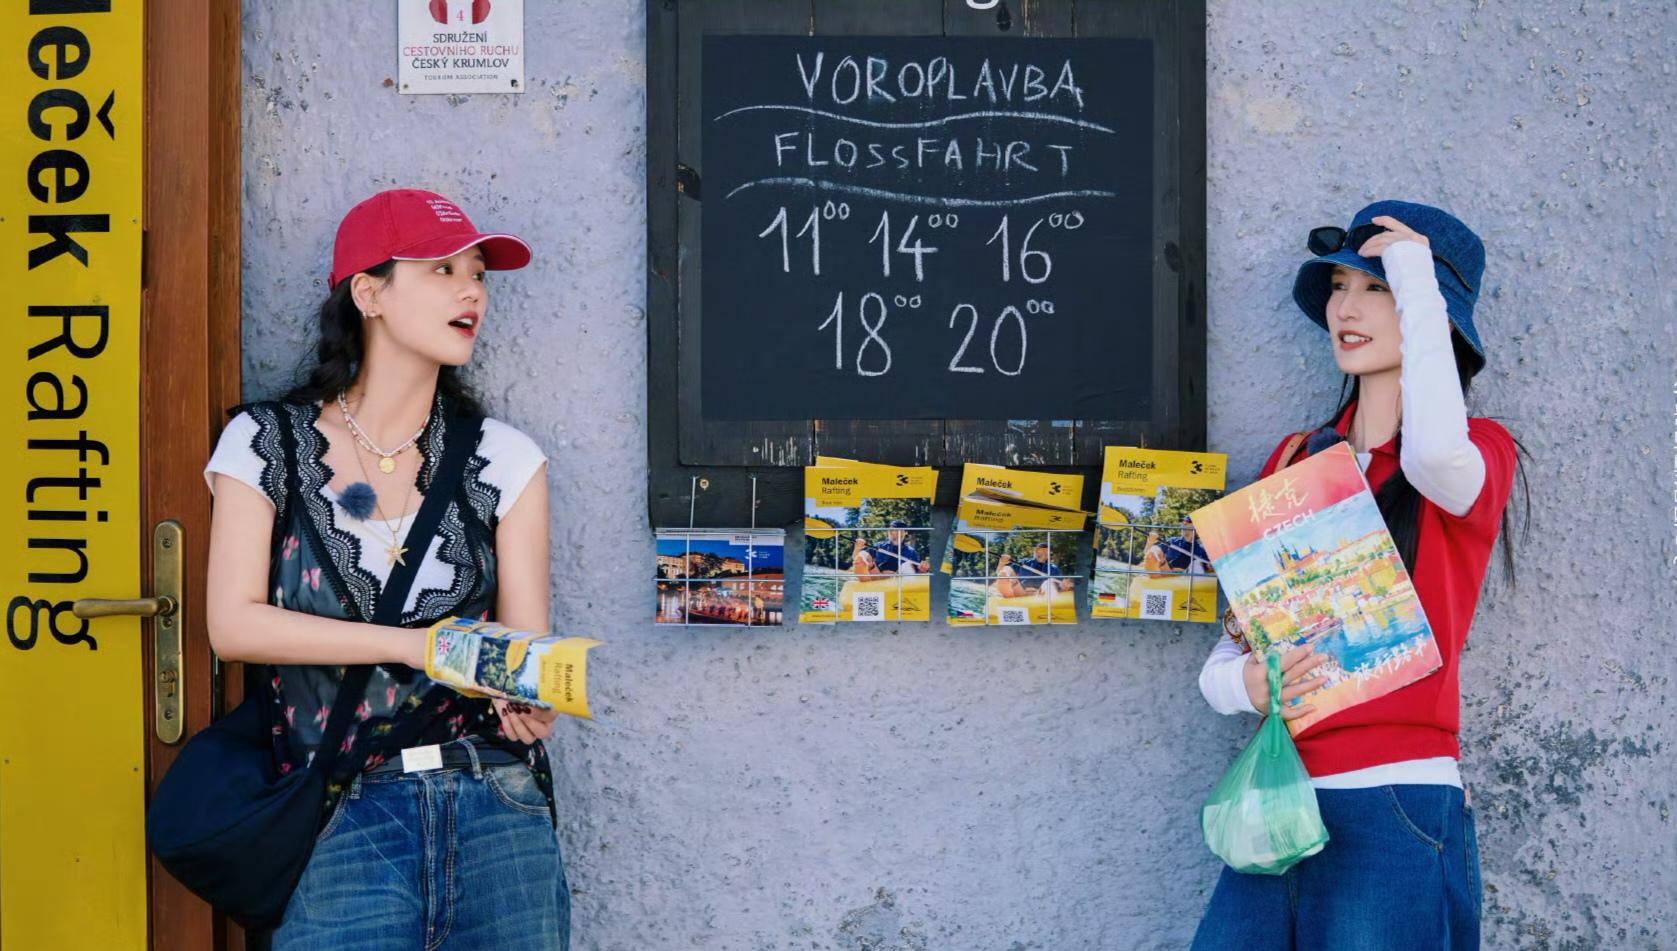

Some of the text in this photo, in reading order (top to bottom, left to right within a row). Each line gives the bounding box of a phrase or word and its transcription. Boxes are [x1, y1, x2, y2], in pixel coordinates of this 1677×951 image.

[456, 9, 464, 21] 4
[433, 30, 488, 43] SDRUŽENÍ
[403, 45, 519, 57] CESTOVNÍHO RUCHU
[411, 57, 509, 69] ČESKÝ KRUMLOV
[796, 51, 1085, 108] VOROPLAVBA
[1118, 459, 1156, 470] Maleček
[7, 304, 111, 651] Rafting
[821, 477, 858, 486] Maleček
[976, 477, 1013, 488] Maleček
[1117, 470, 1149, 483] Rafting
[821, 486, 851, 496] Rafting
[1262, 510, 1315, 541] CZECH
